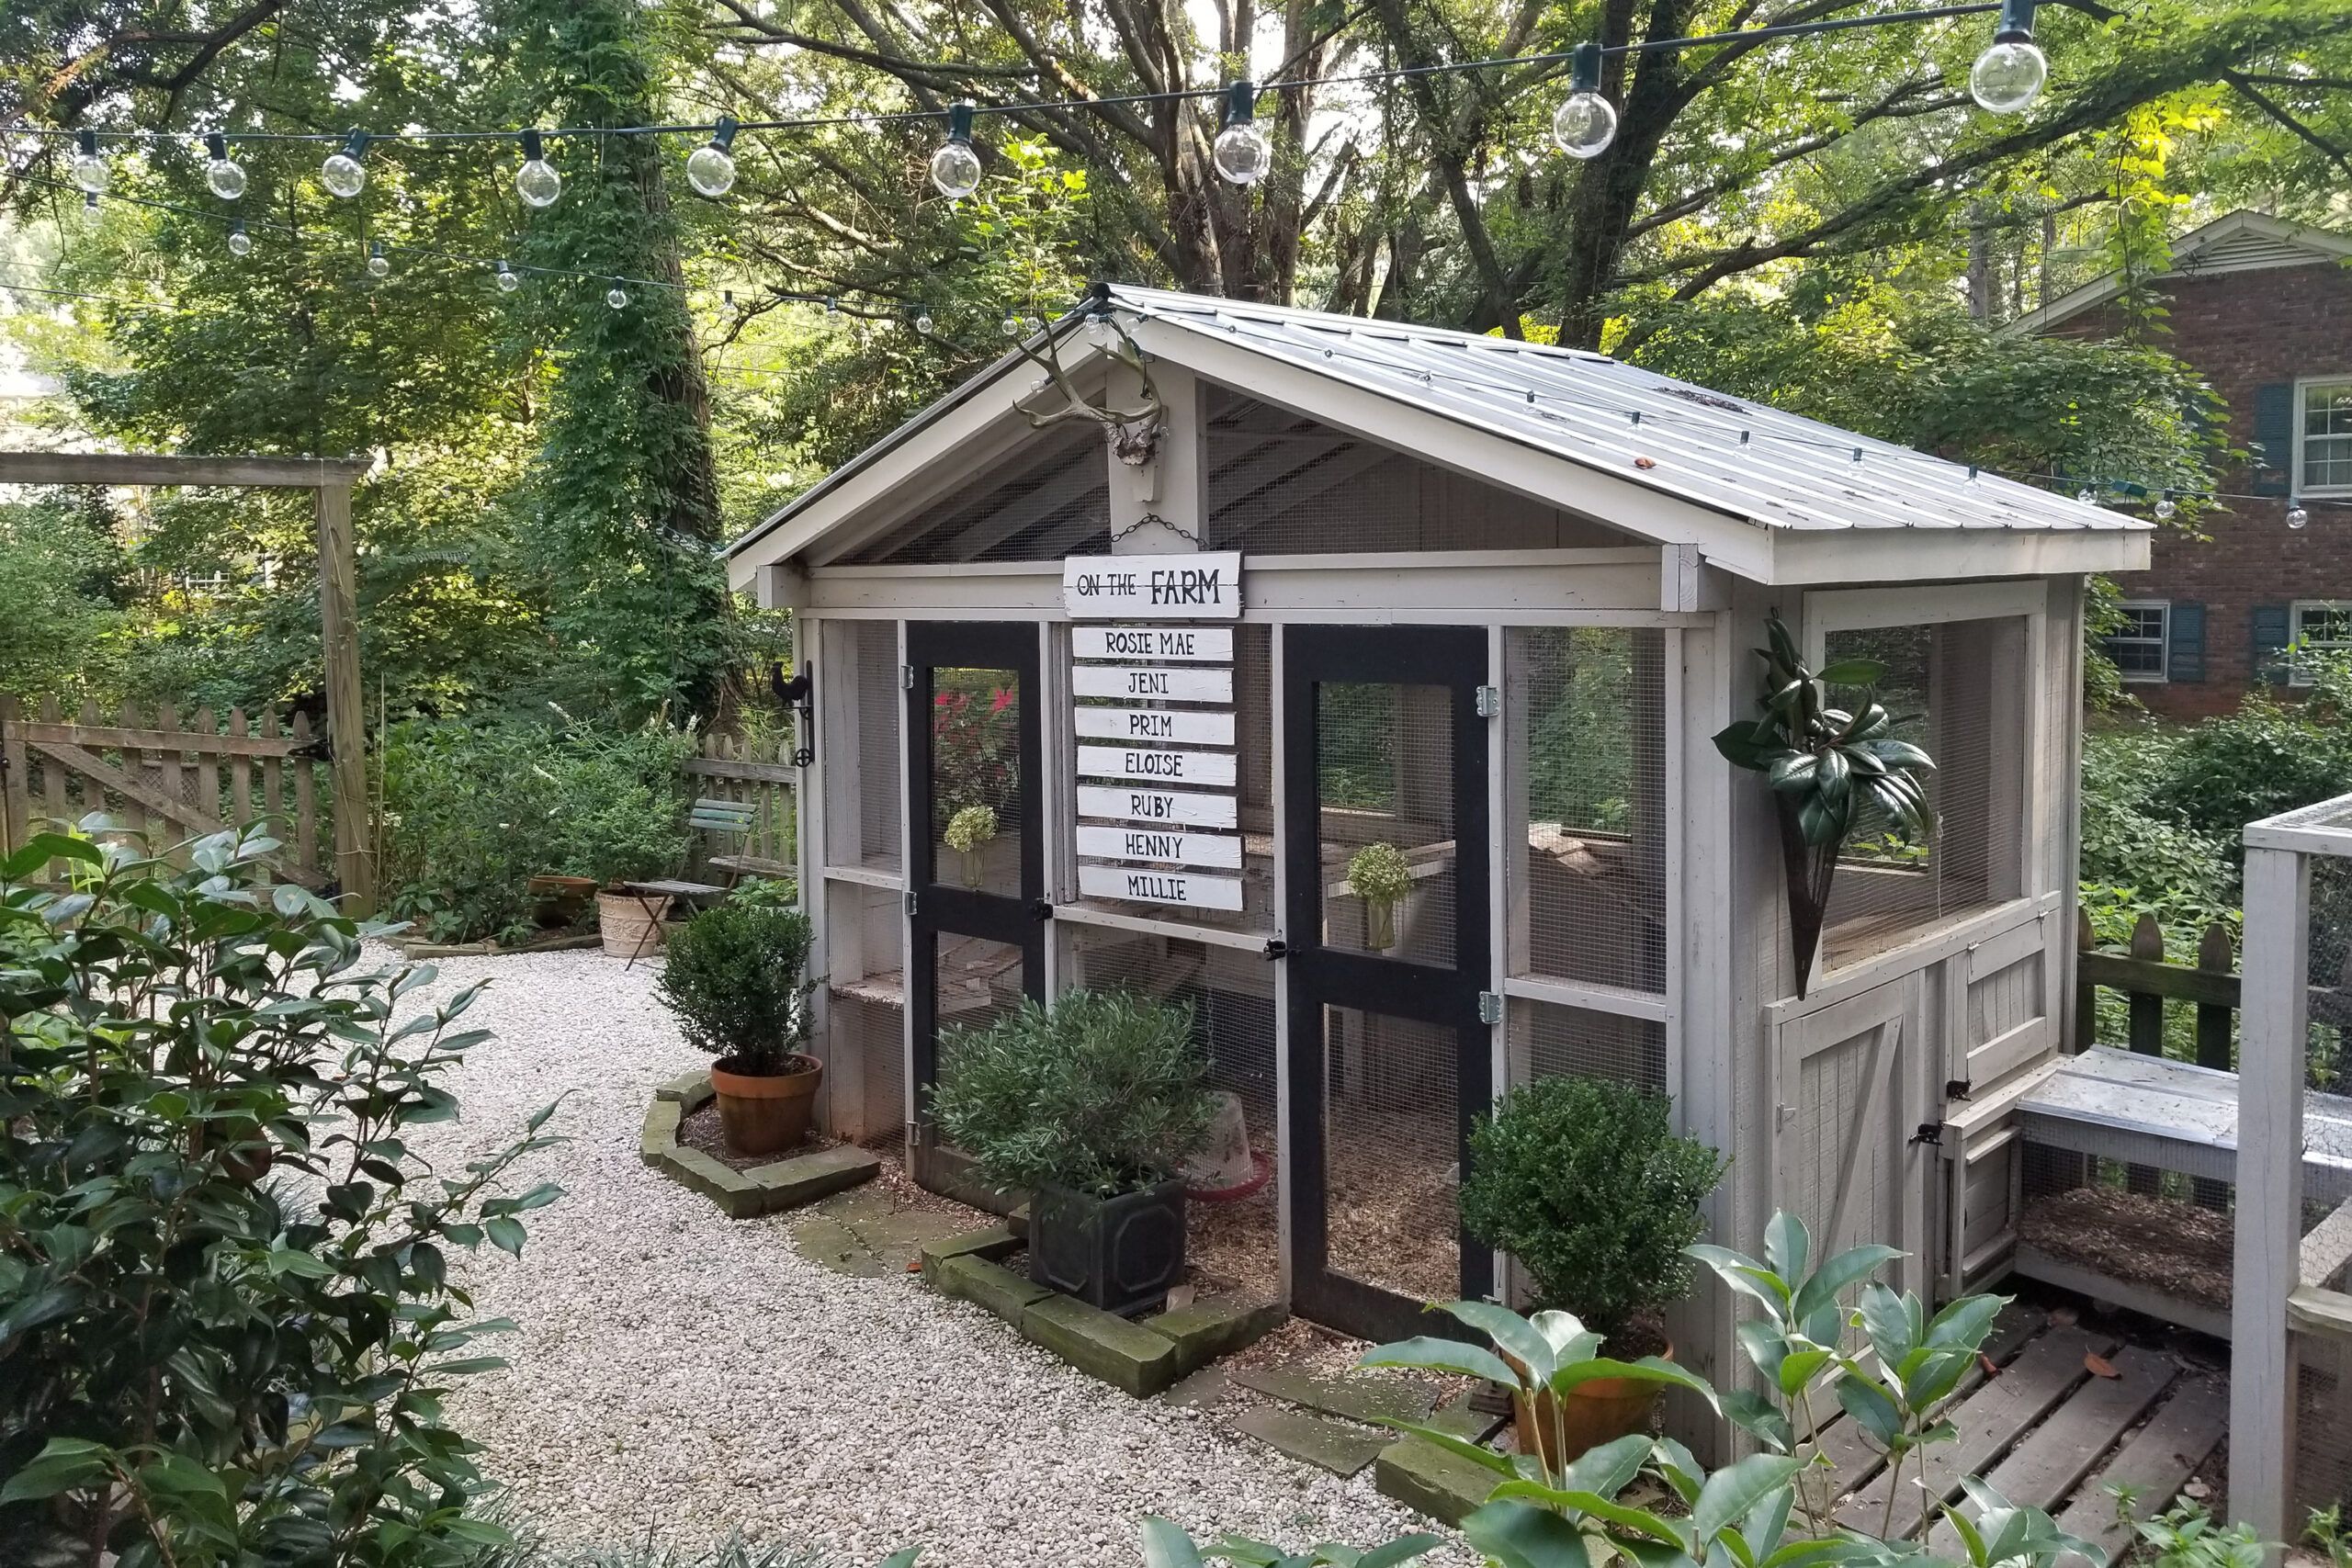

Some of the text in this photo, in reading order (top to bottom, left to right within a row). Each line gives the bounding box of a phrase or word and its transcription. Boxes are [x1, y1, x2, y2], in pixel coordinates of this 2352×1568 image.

[1078, 569, 1220, 604] ON THE FARM
[1105, 632, 1194, 655] ROSIE MAE
[1128, 672, 1169, 694] JENI
[1129, 714, 1172, 737] PRIM
[1125, 752, 1183, 776] ELOISE
[1131, 795, 1173, 818] RUBY
[1125, 834, 1182, 859] HENNY
[1127, 874, 1187, 901] MILLIE
